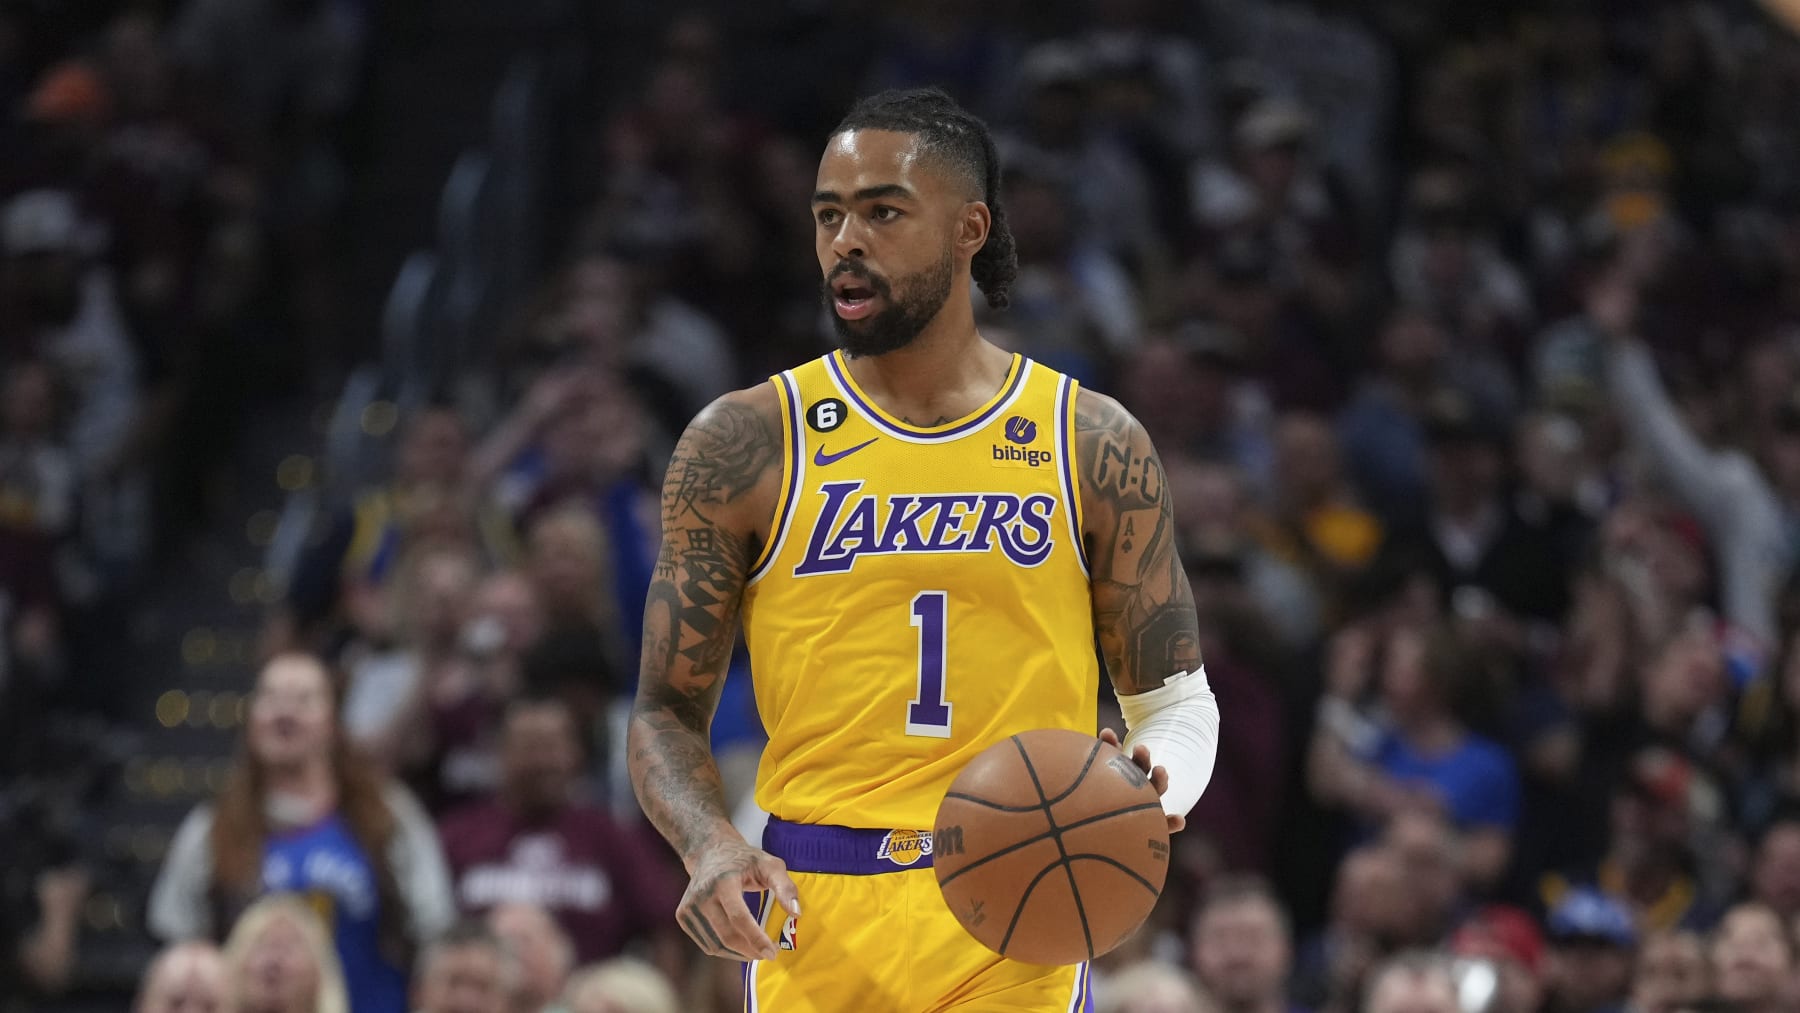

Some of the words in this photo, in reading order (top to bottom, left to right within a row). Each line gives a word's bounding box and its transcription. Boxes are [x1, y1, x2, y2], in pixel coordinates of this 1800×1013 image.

[815, 401, 839, 429] 6
[992, 444, 1052, 467] bibigo
[792, 479, 1057, 578] LAKERS
[1123, 516, 1136, 537] A
[904, 590, 952, 738] 1
[877, 836, 932, 859] LAKERS
